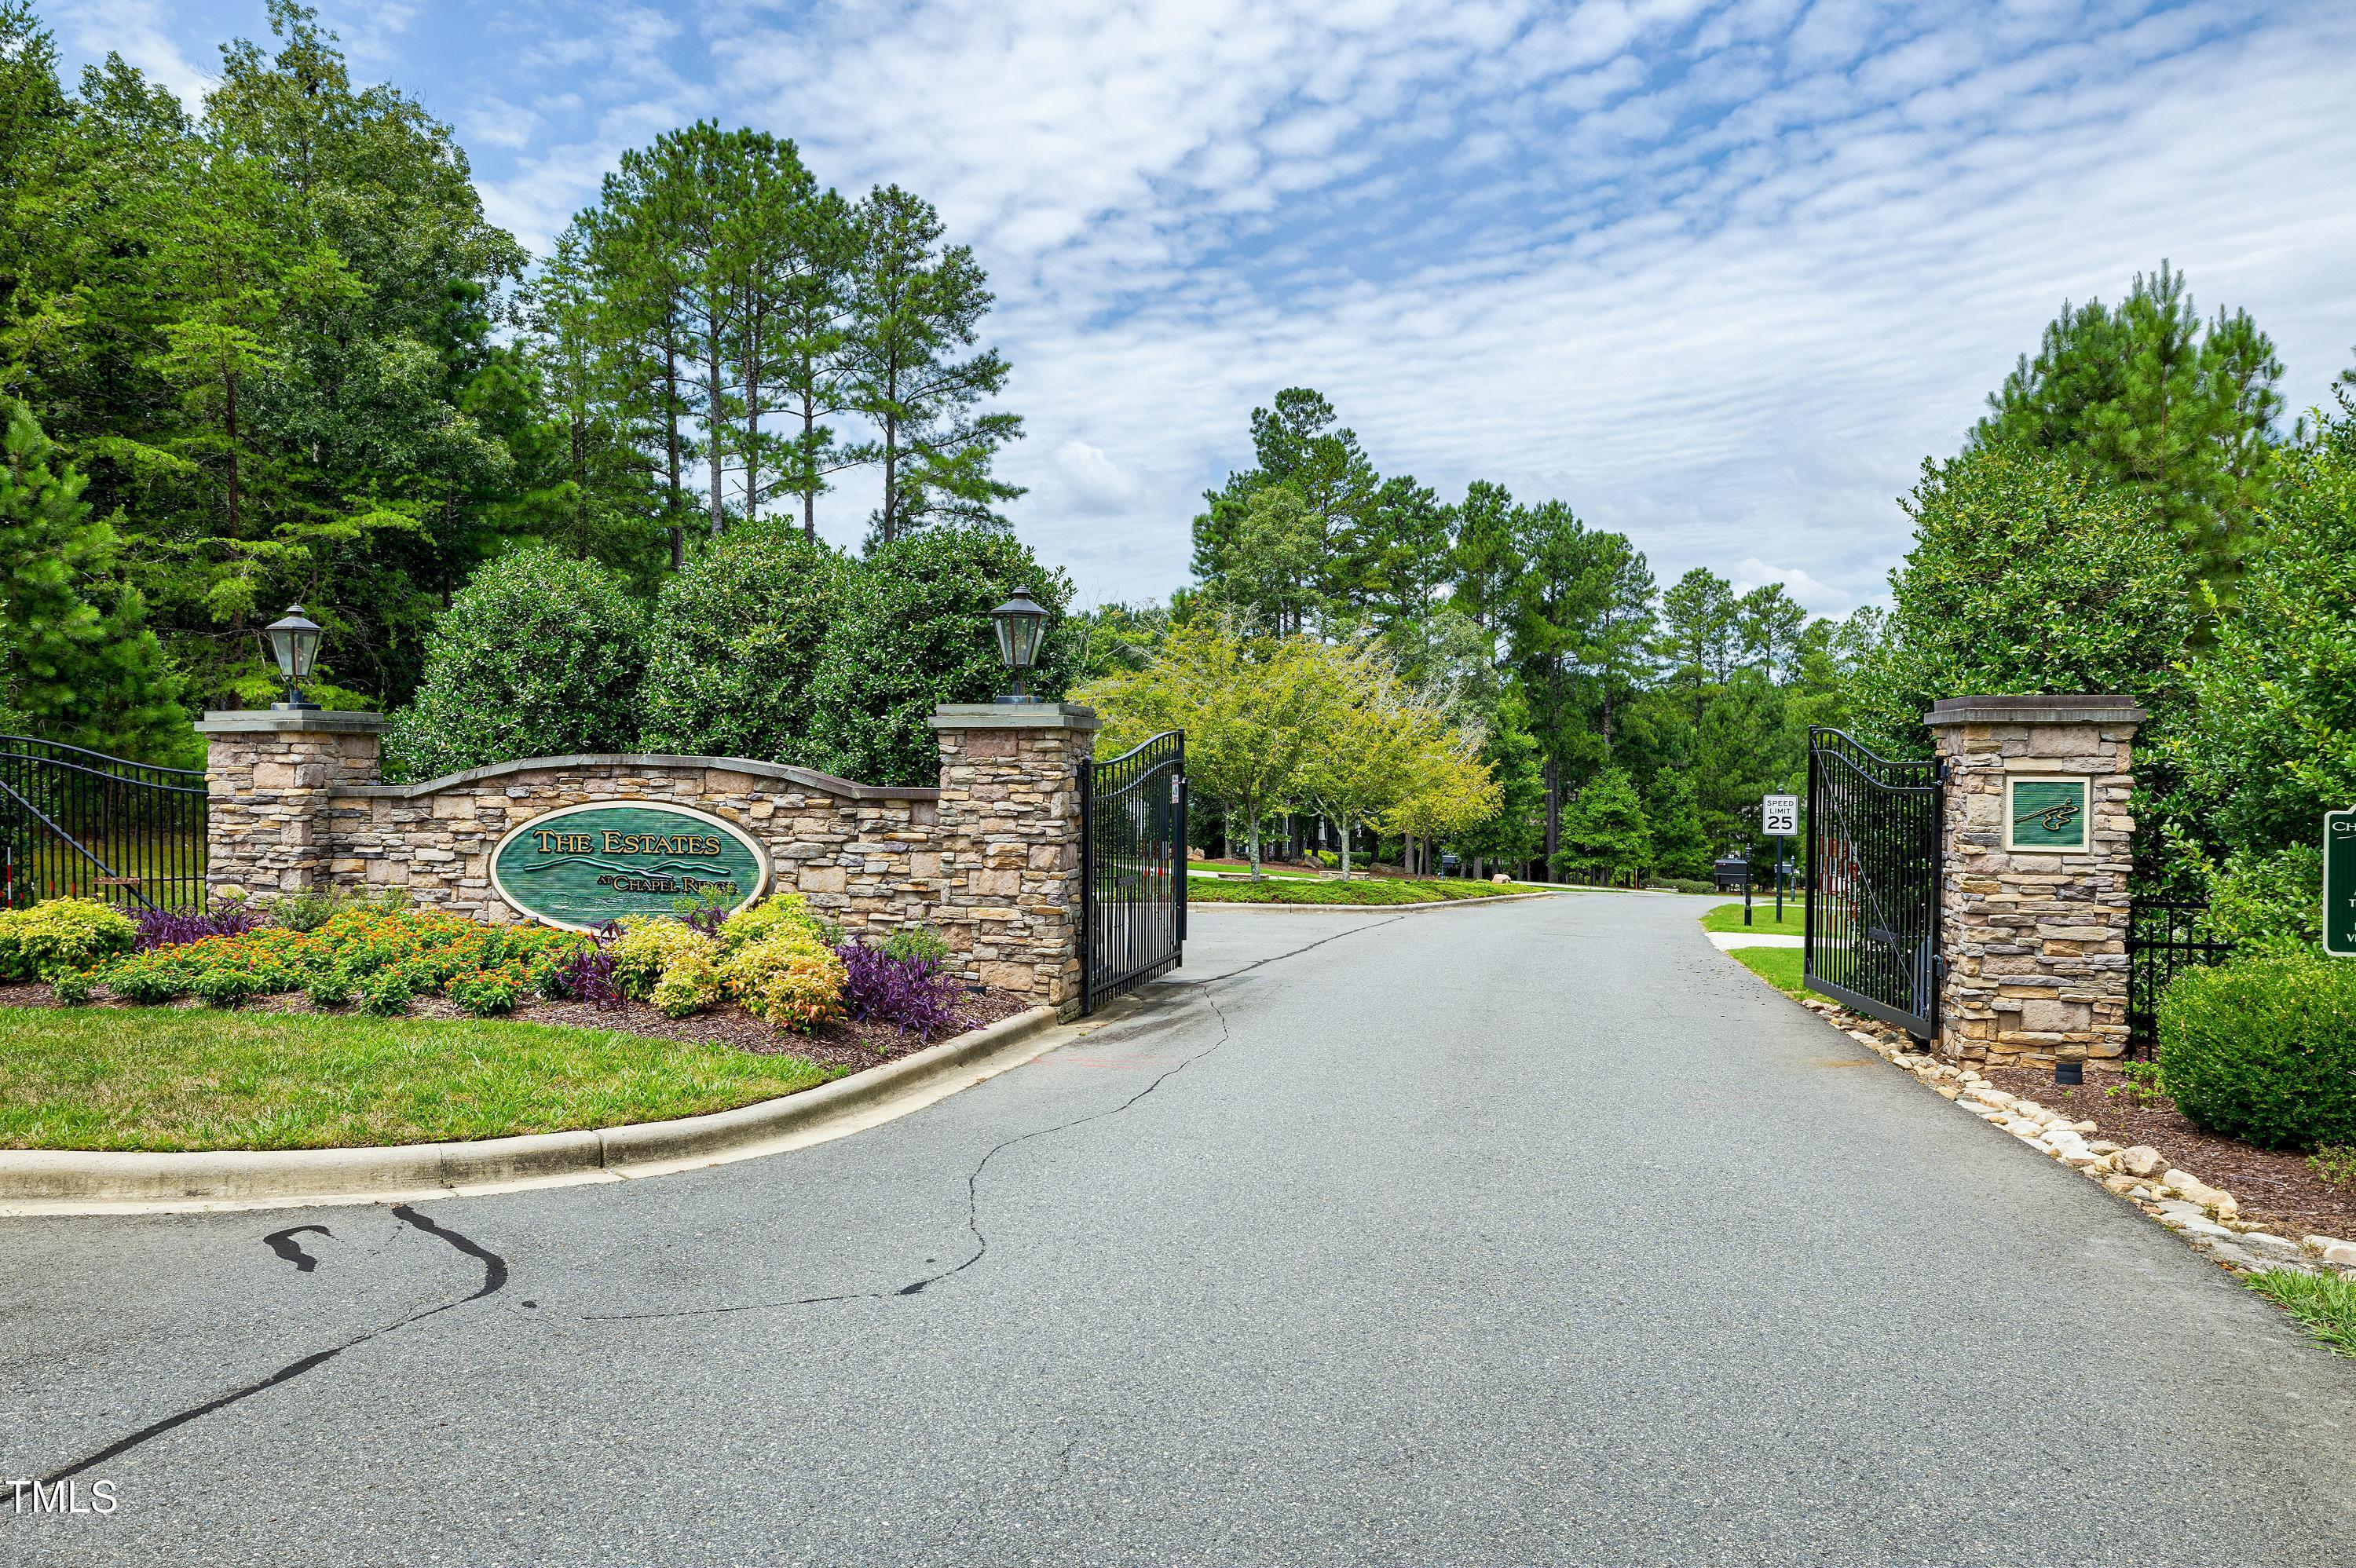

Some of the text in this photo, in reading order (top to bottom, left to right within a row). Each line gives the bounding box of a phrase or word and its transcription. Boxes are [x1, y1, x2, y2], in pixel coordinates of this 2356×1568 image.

[1767, 815, 1793, 830] 25
[534, 829, 720, 855] THE ESTATES
[598, 875, 613, 885] AT
[613, 876, 679, 893] CHAPEL
